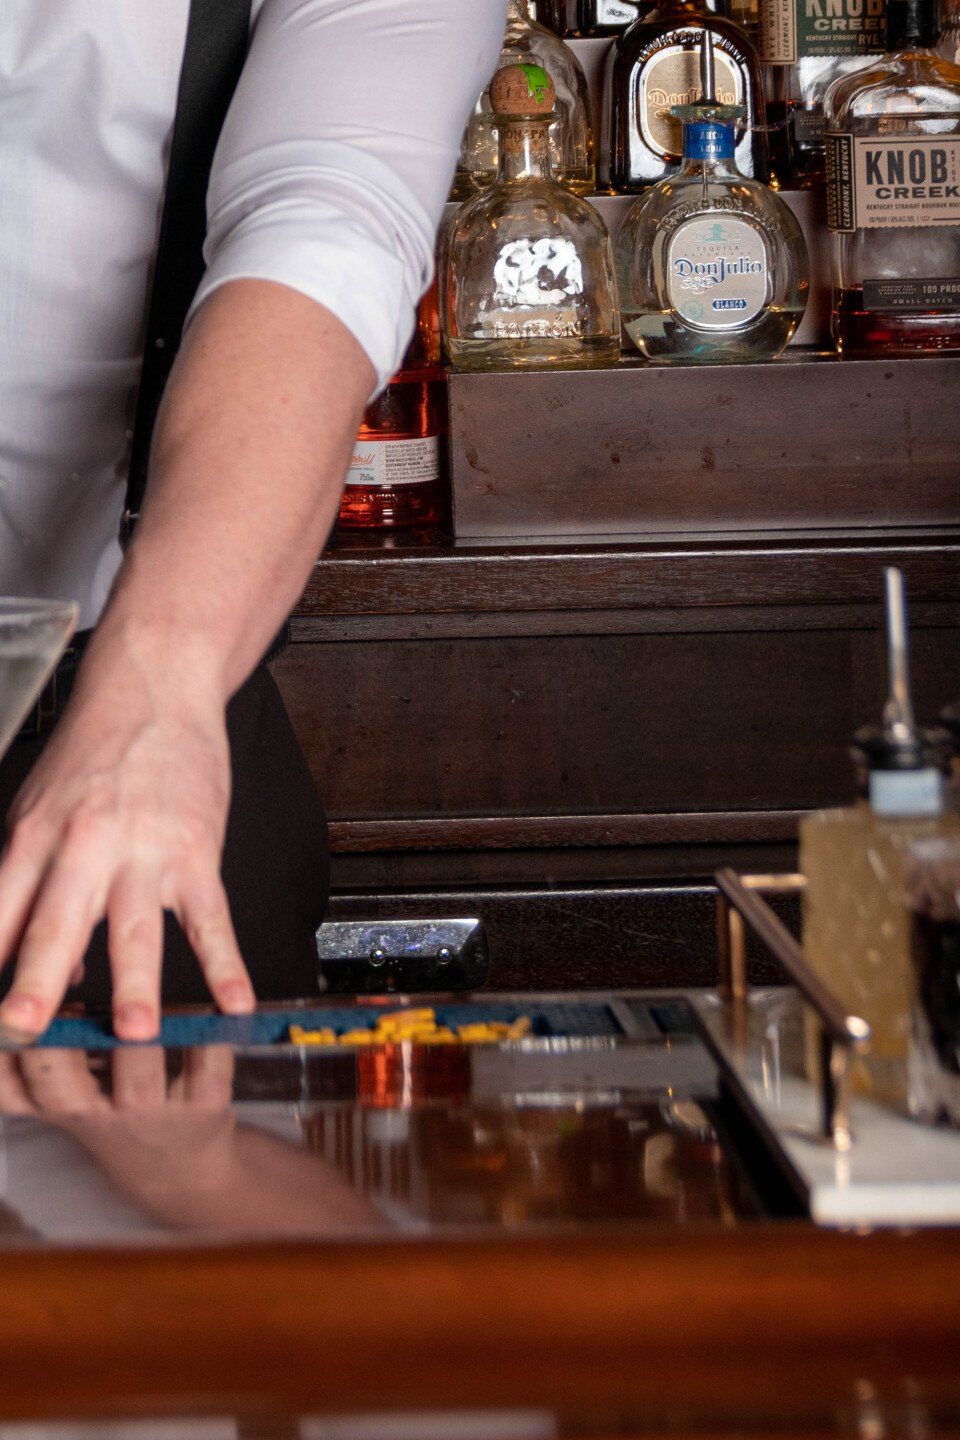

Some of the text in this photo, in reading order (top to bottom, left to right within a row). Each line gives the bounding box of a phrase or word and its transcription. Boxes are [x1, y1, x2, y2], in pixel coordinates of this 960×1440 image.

[859, 34, 879, 45] RYE
[841, 139, 850, 180] KENTUCKY
[865, 148, 948, 185] KNOB
[875, 185, 960, 200] CREEK
[866, 202, 893, 210] KENTUCKY
[895, 202, 920, 210] STRAIGHT
[715, 300, 744, 309] BLANCO
